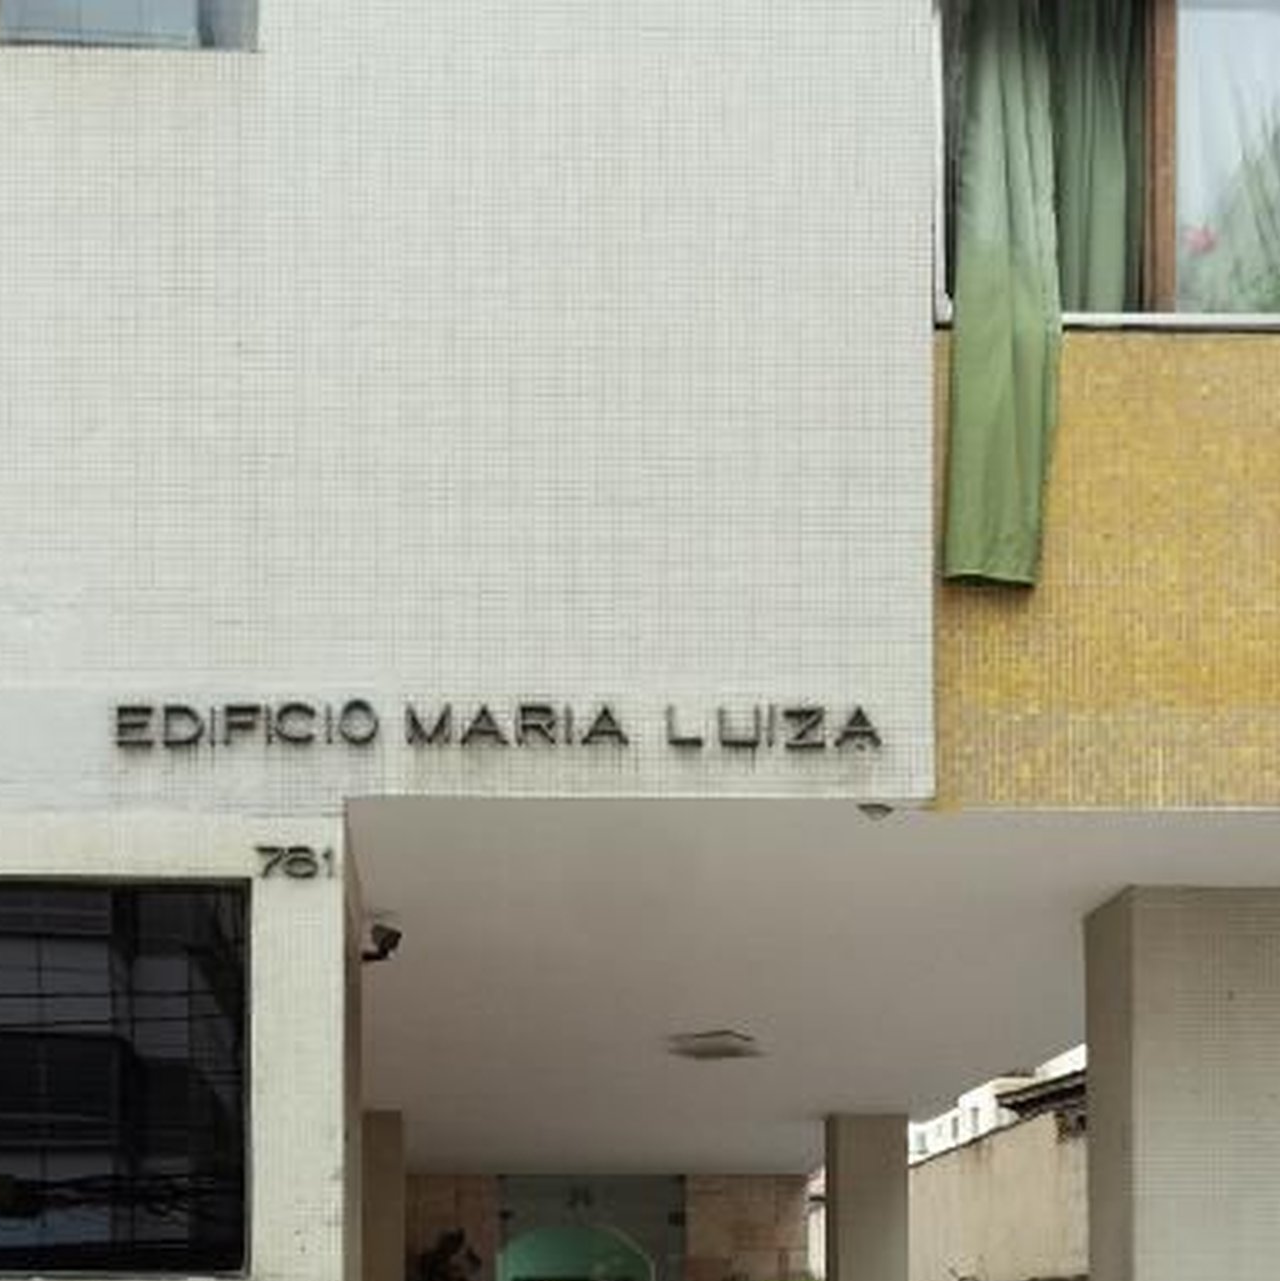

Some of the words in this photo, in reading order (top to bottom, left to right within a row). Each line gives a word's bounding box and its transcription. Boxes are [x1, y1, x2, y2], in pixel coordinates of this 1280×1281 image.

[115, 699, 380, 748] EDIFICIO
[404, 702, 629, 748] MARIA
[667, 703, 884, 751] LUIZA
